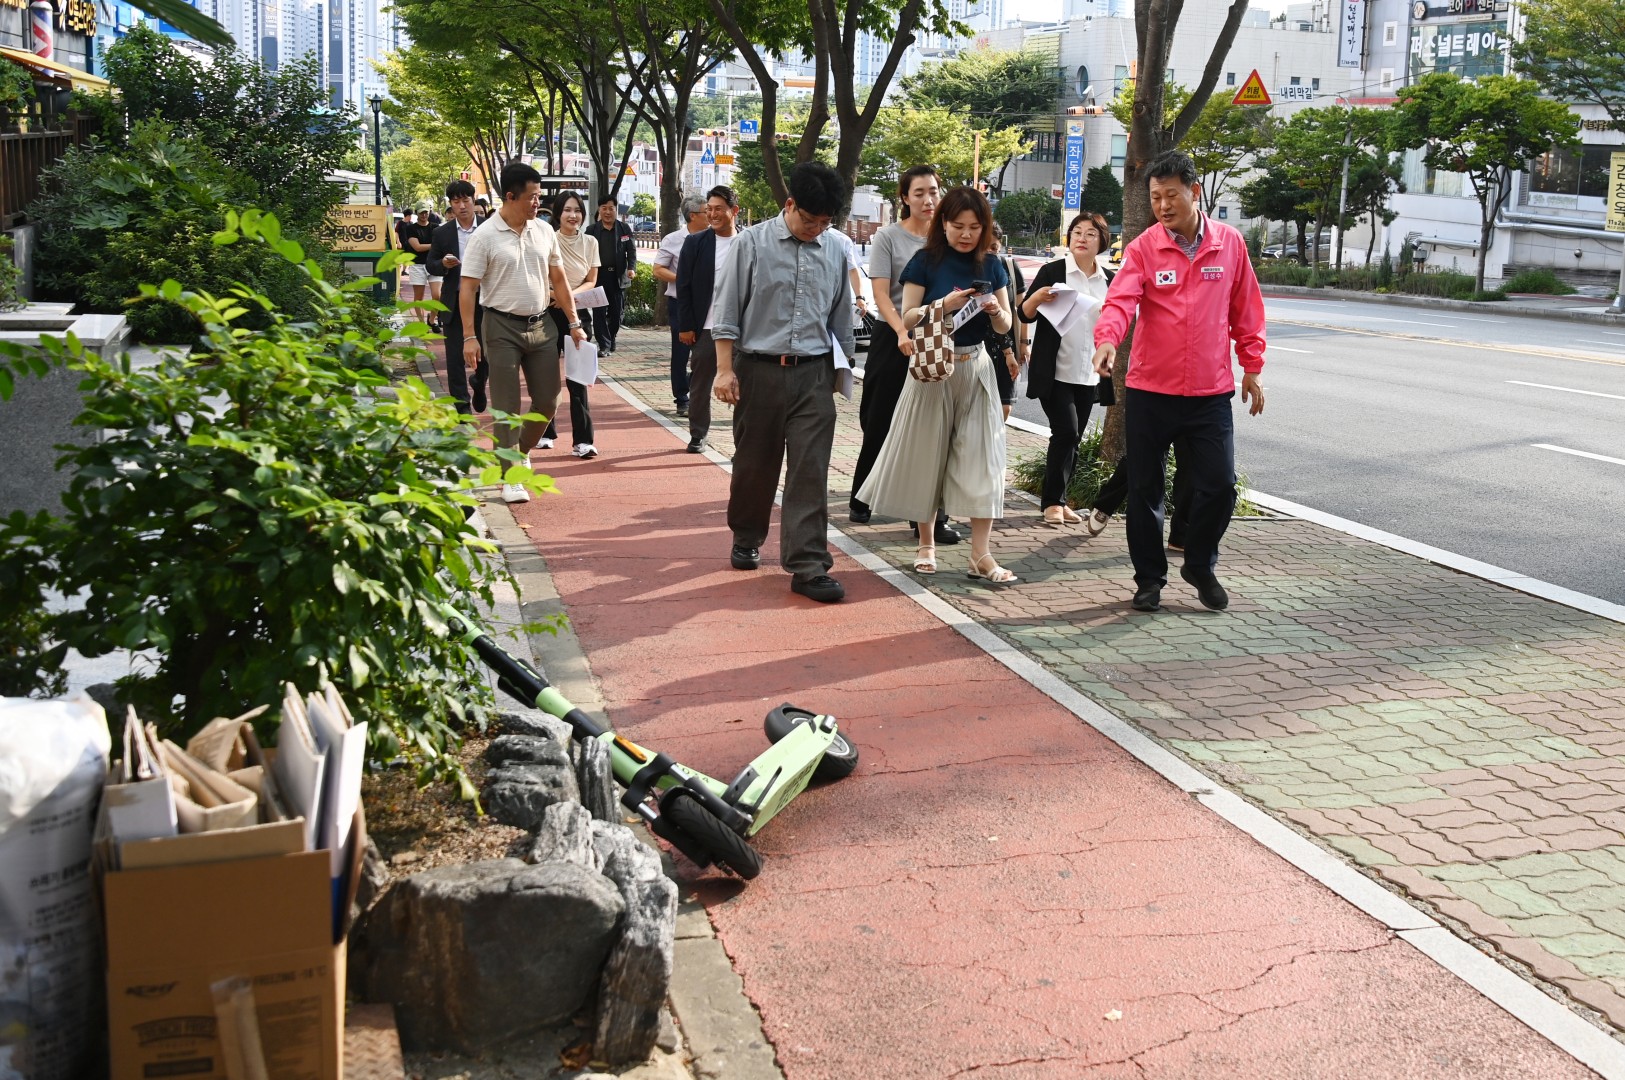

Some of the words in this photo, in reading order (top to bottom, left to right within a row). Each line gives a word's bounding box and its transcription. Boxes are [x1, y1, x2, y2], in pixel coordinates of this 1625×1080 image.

[1247, 86, 1259, 94] 위험
[1280, 87, 1312, 99] 내리막길
[1067, 145, 1081, 205] 좌동성당
